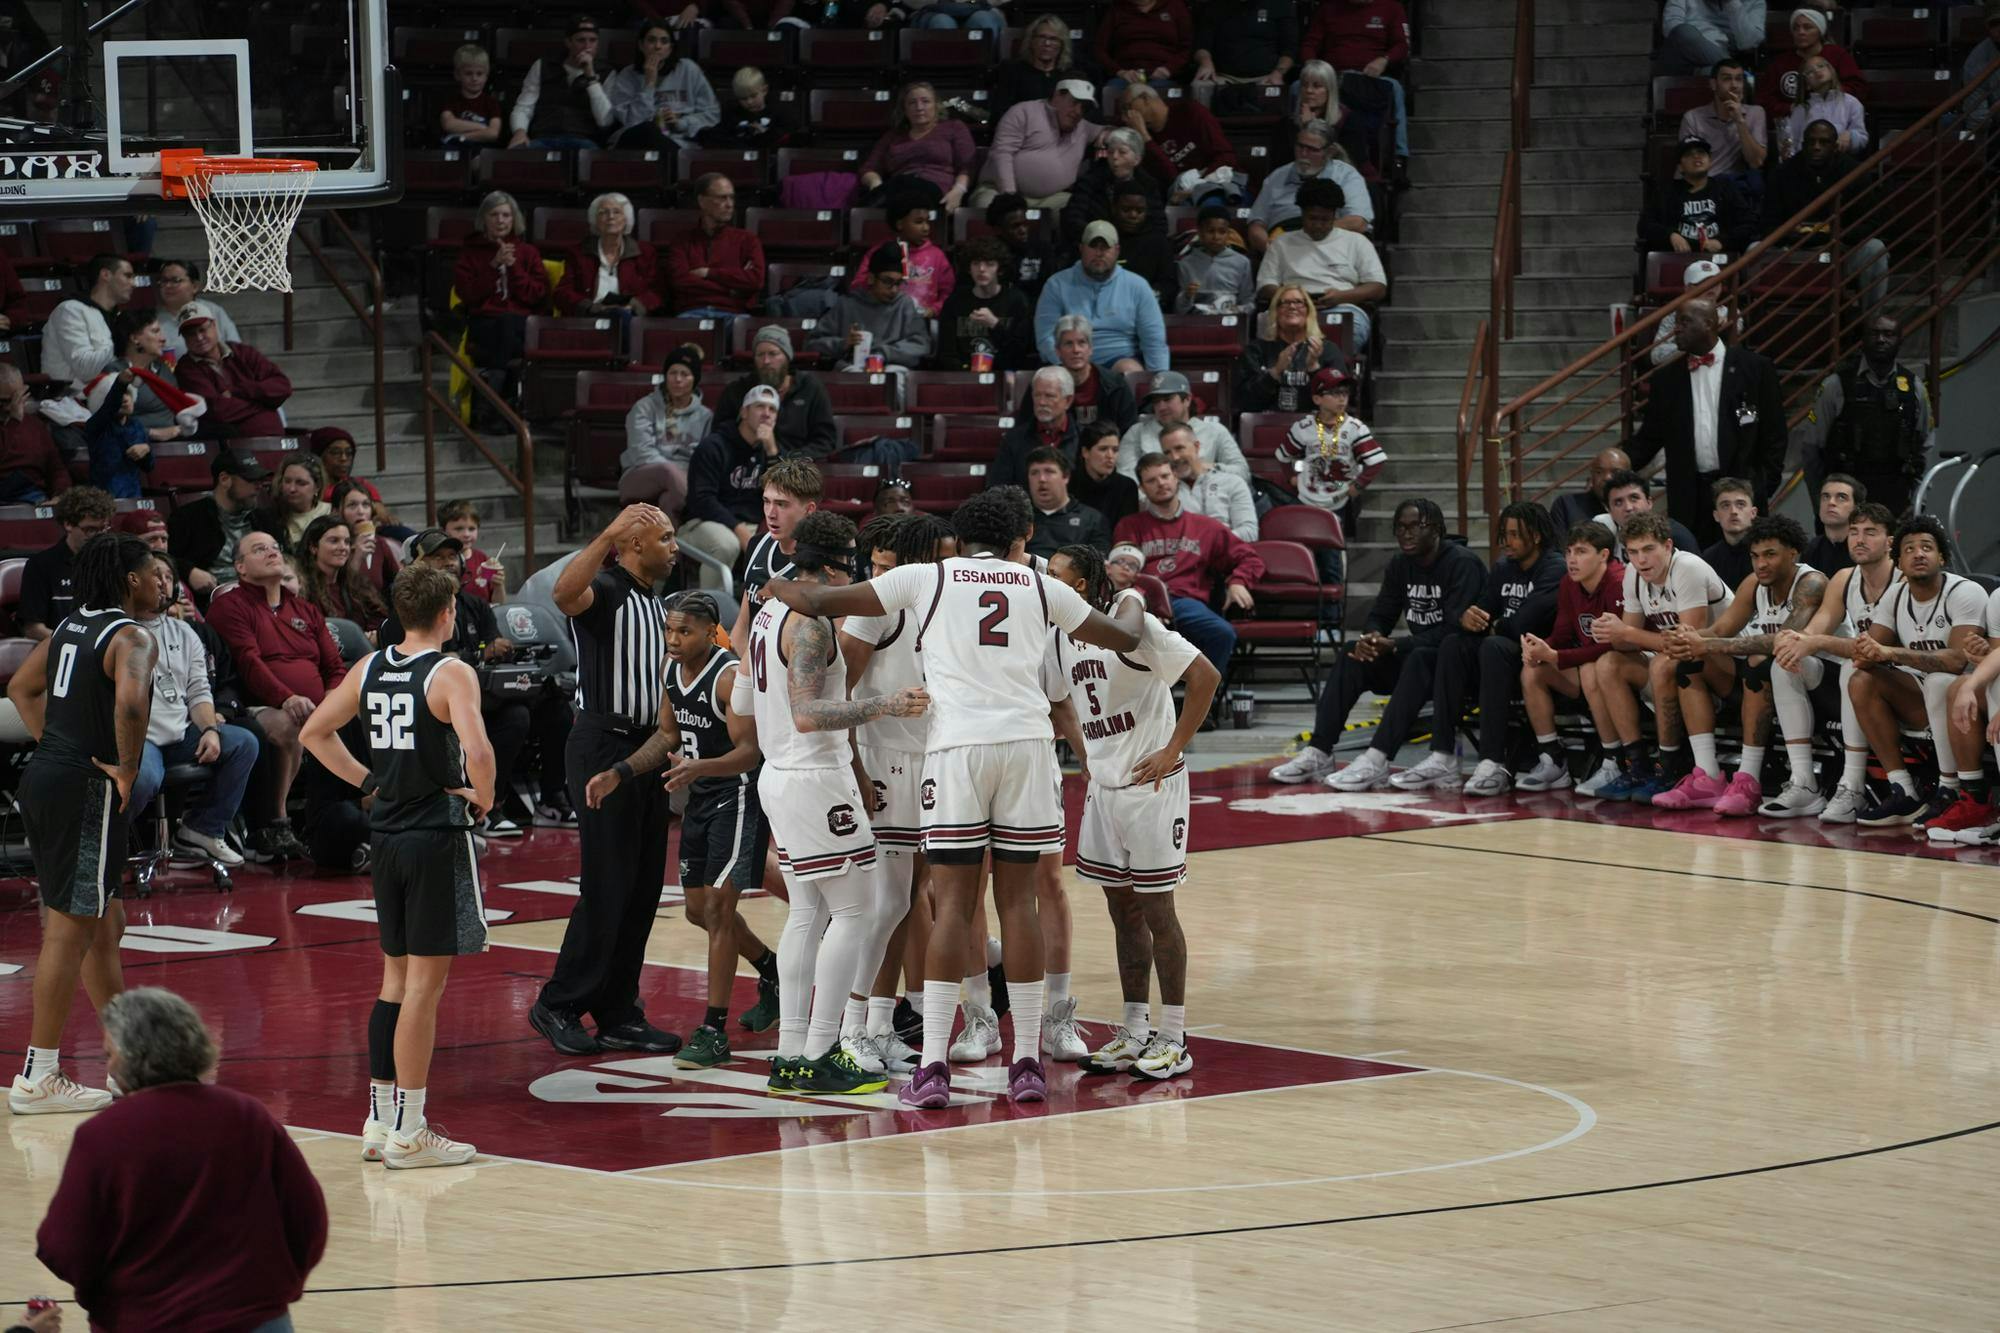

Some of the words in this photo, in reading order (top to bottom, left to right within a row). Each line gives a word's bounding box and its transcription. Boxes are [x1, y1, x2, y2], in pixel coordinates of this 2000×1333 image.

[953, 569, 1031, 587] ESSANDOKO
[978, 590, 1009, 647] 2
[52, 642, 78, 698] 0
[750, 631, 767, 693] 10
[1071, 659, 1108, 686] SOUTH
[1085, 682, 1101, 716] 5
[367, 692, 415, 750] 32
[1082, 711, 1136, 741] CAROLINA
[680, 730, 700, 760] 3
